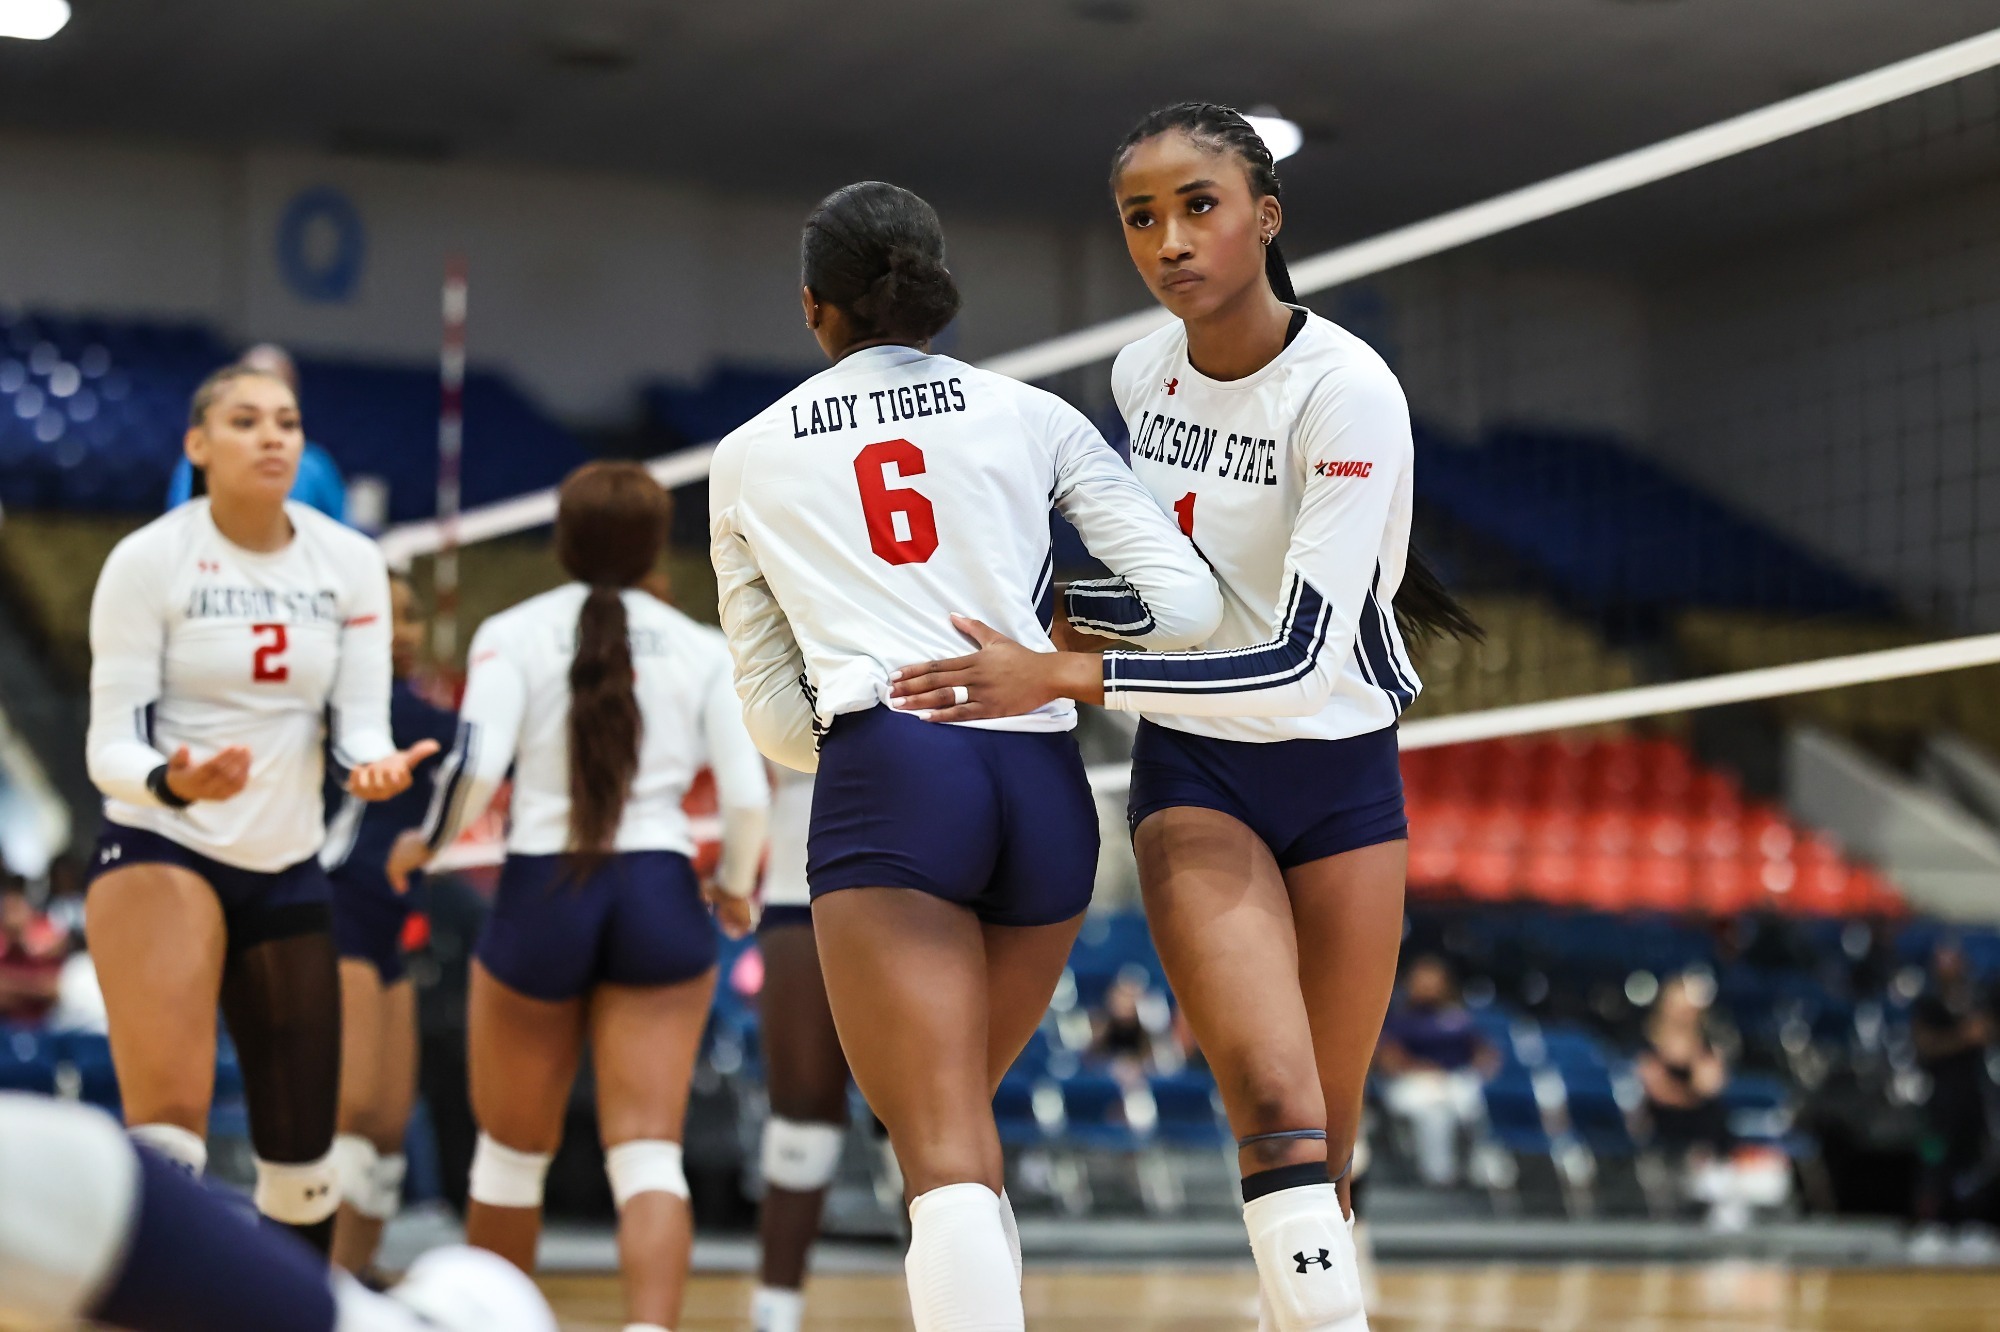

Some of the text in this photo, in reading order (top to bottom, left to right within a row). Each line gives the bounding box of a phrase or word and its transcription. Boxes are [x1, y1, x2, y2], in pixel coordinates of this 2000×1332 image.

[791, 377, 966, 439] LADY TIGERS
[1132, 410, 1278, 486] JACKSON STATE
[1325, 461, 1373, 478] SWAC
[853, 438, 939, 566] 6
[1173, 491, 1197, 540] 1
[252, 623, 289, 683] 2
